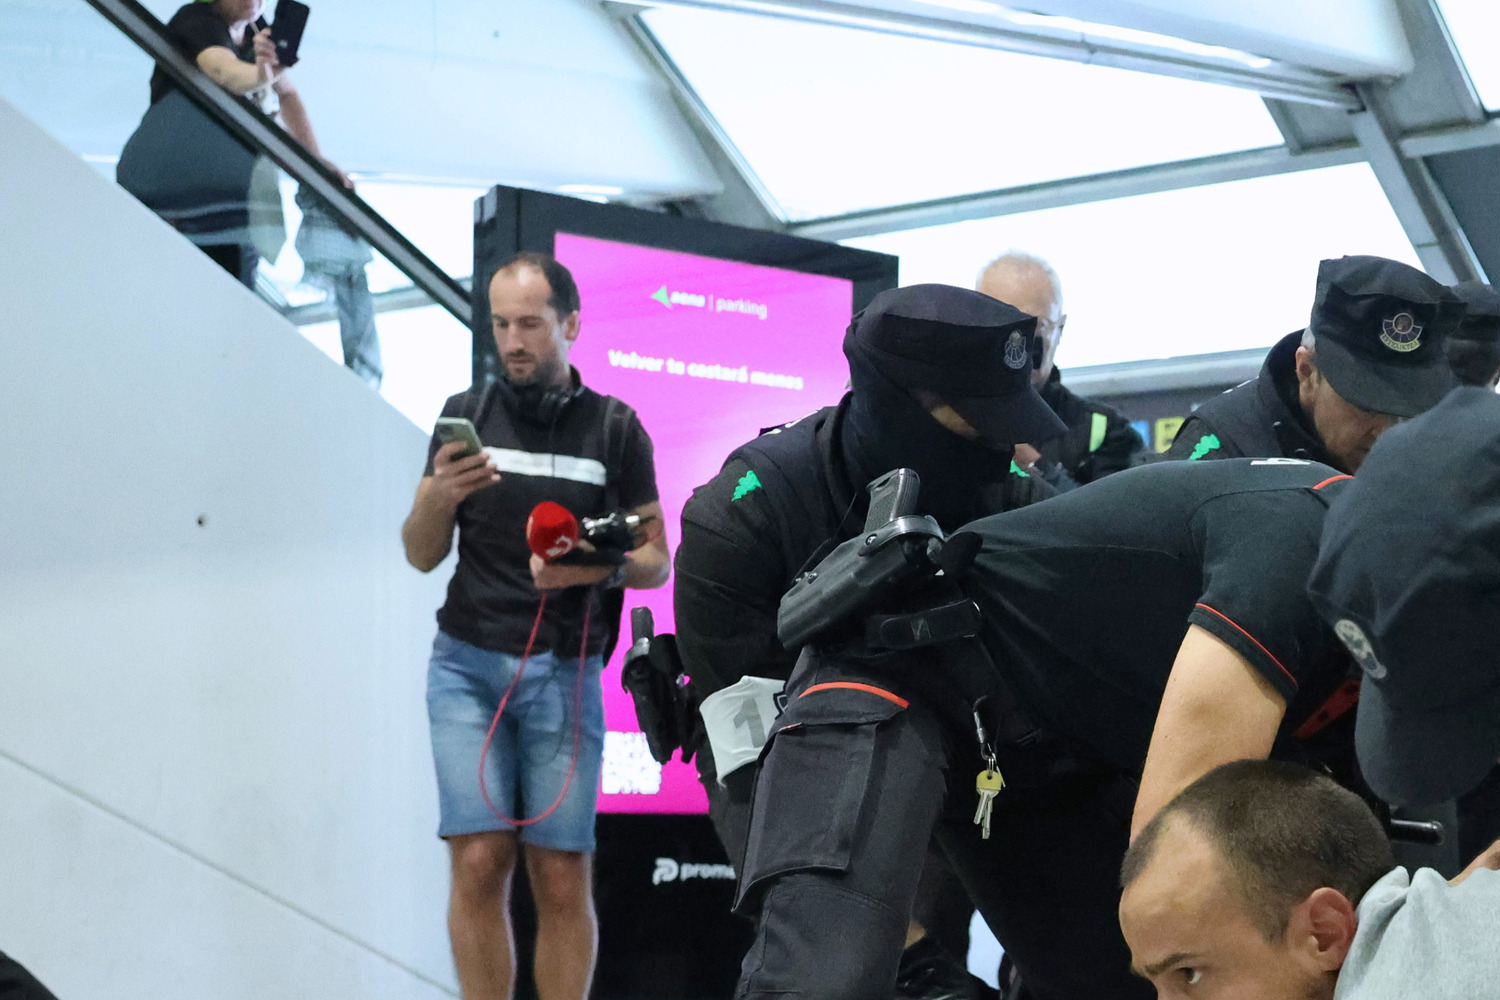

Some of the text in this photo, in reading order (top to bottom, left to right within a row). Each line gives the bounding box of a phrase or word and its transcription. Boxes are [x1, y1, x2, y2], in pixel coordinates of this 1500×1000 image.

[716, 297, 768, 320] parking
[608, 349, 804, 390] Volver te costará menos
